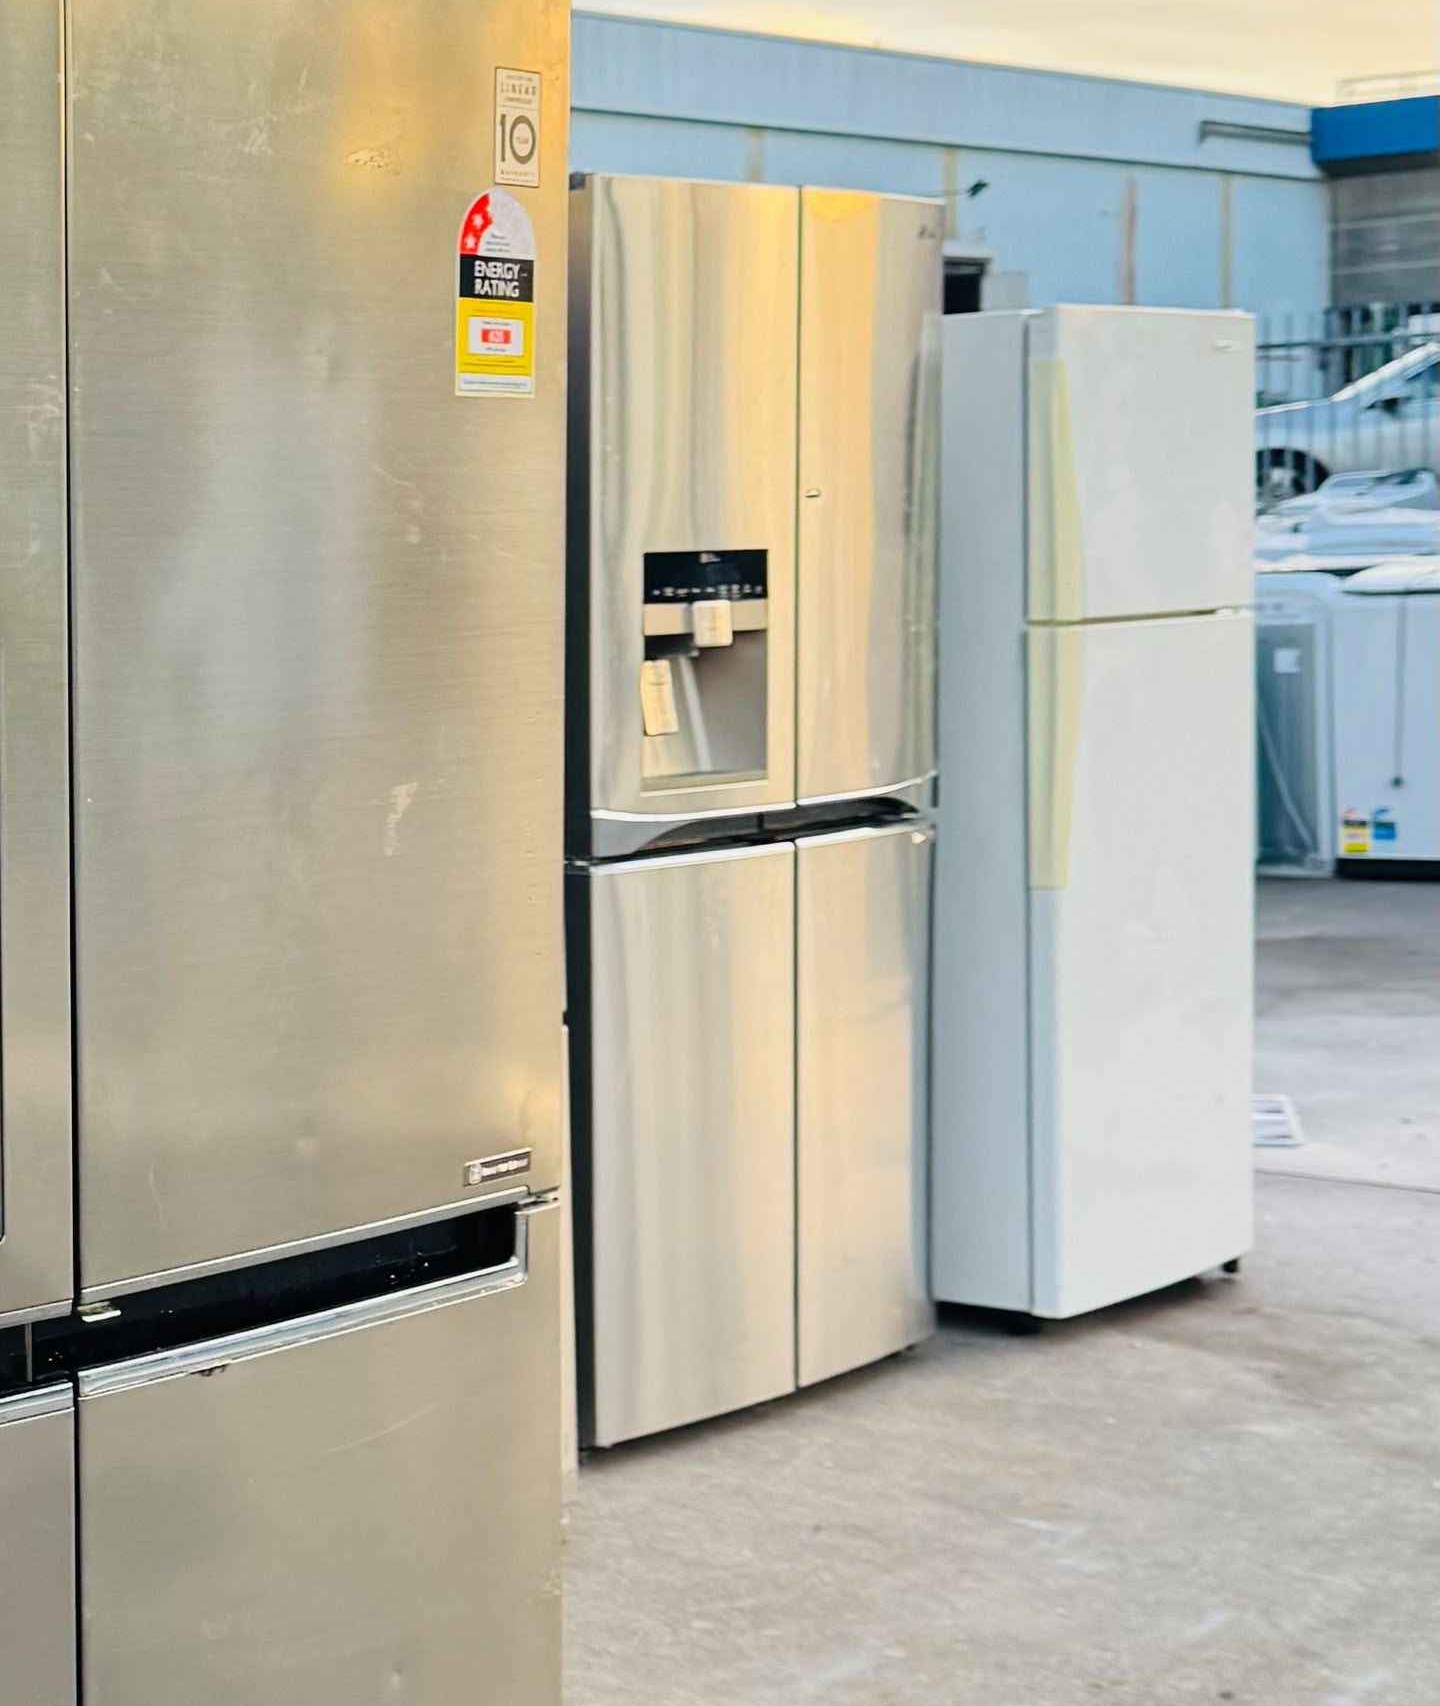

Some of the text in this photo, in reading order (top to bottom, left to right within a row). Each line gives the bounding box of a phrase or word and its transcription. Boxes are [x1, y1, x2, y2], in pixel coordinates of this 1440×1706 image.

[499, 113, 537, 165] 10
[473, 260, 521, 280] ENERGY
[474, 278, 520, 298] RATING
